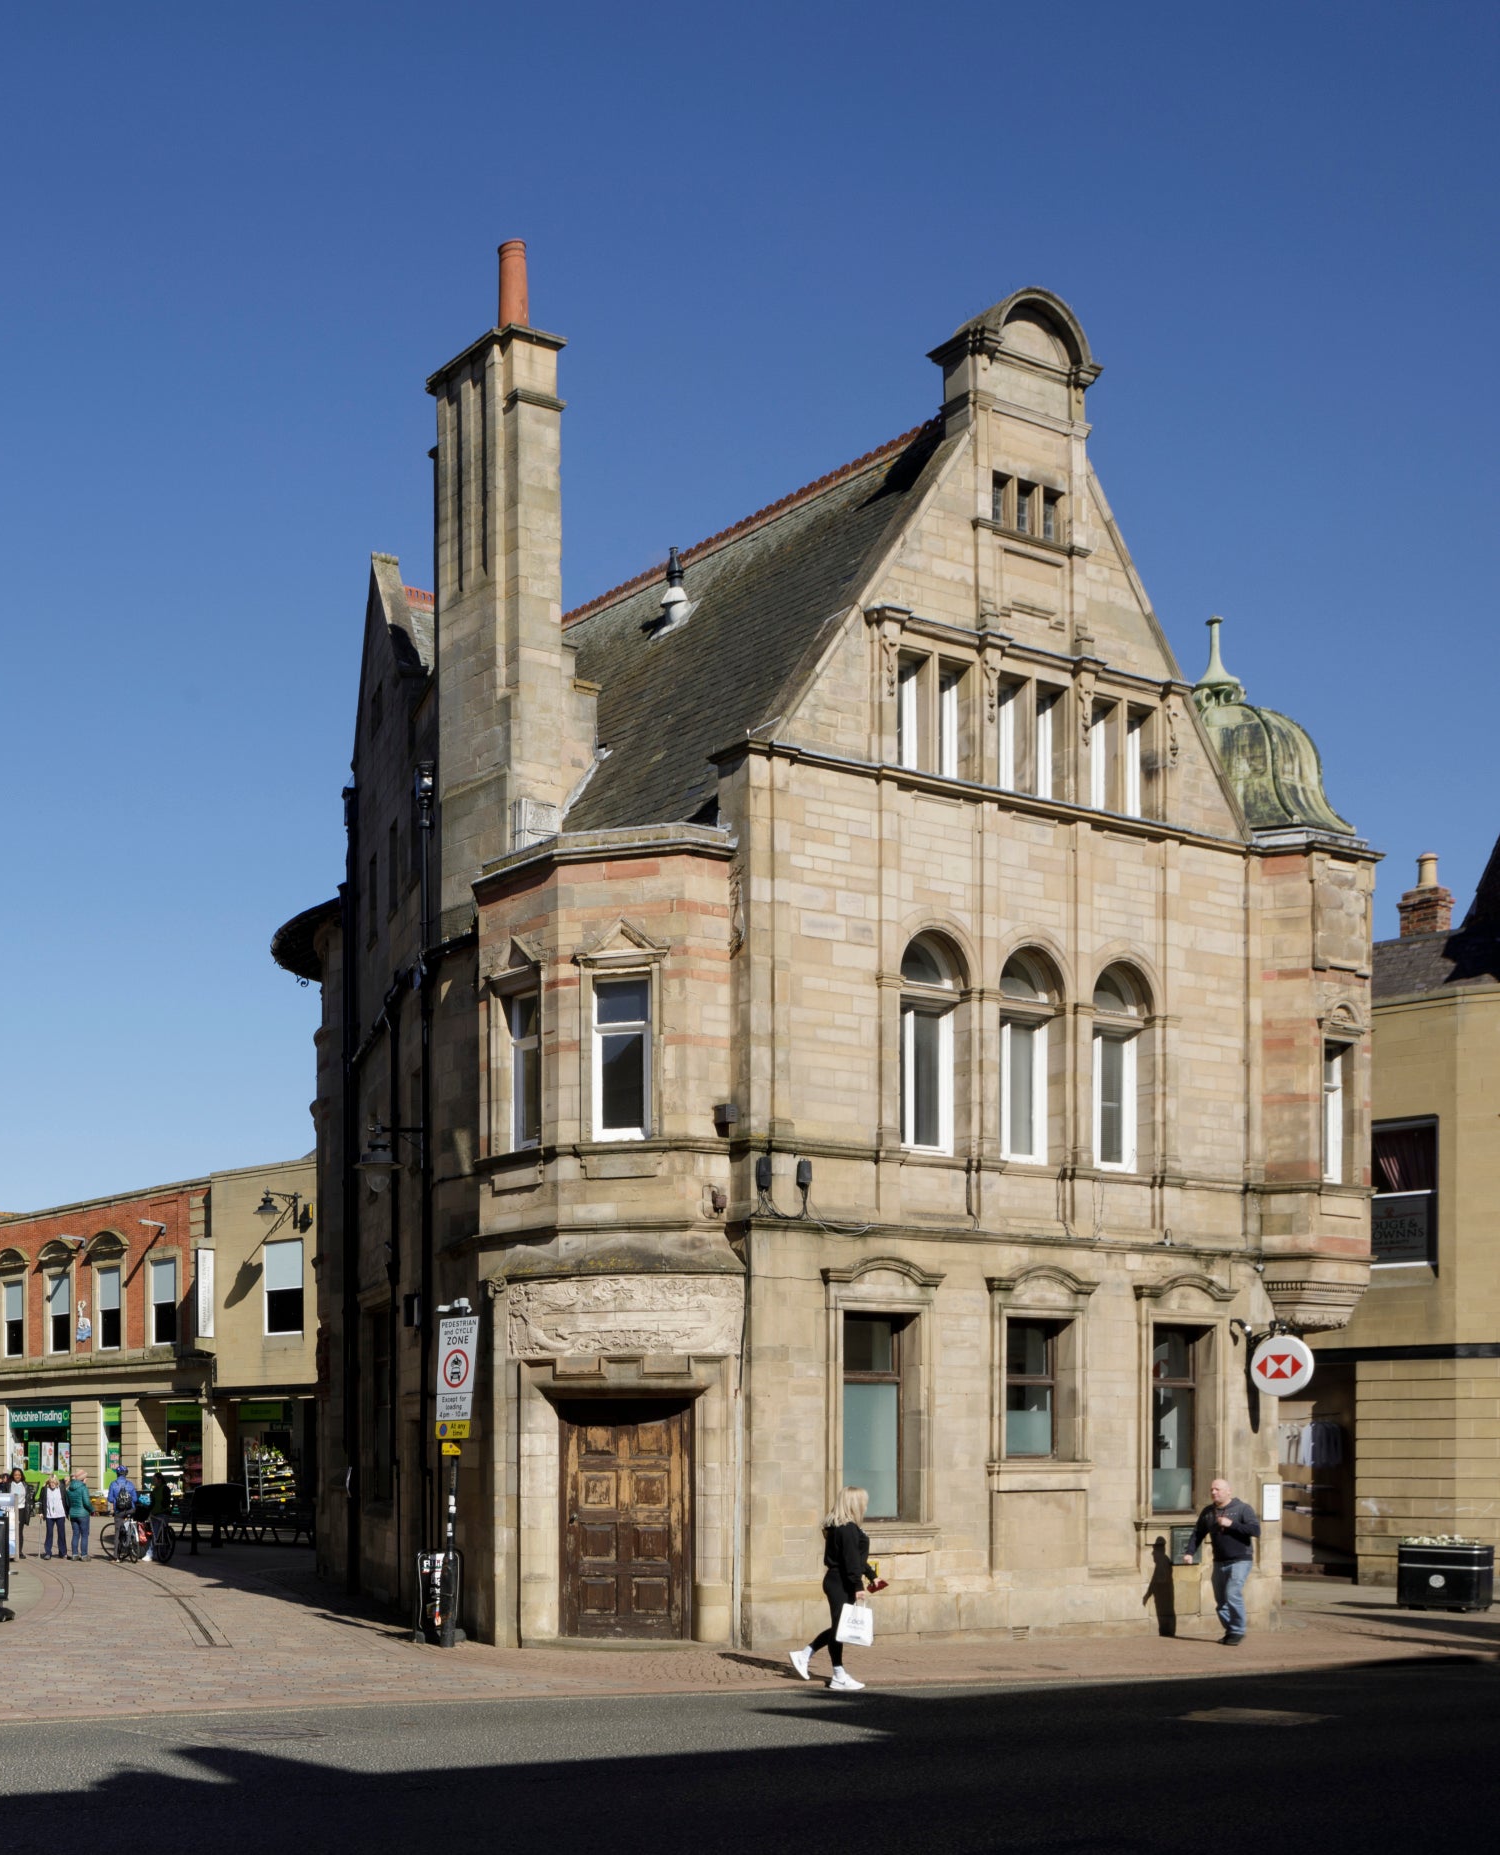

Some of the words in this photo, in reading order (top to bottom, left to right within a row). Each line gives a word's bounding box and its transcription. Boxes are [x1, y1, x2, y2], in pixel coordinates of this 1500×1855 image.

[1372, 1220, 1405, 1230] OUGE
[1372, 1227, 1425, 1240] OWNNS
[441, 1319, 477, 1328] PEDESTRIAN
[444, 1328, 454, 1336] and
[455, 1327, 473, 1335] CYCLE
[446, 1336, 469, 1346] ZONE
[441, 1396, 458, 1404] Except
[445, 1403, 463, 1411] loading
